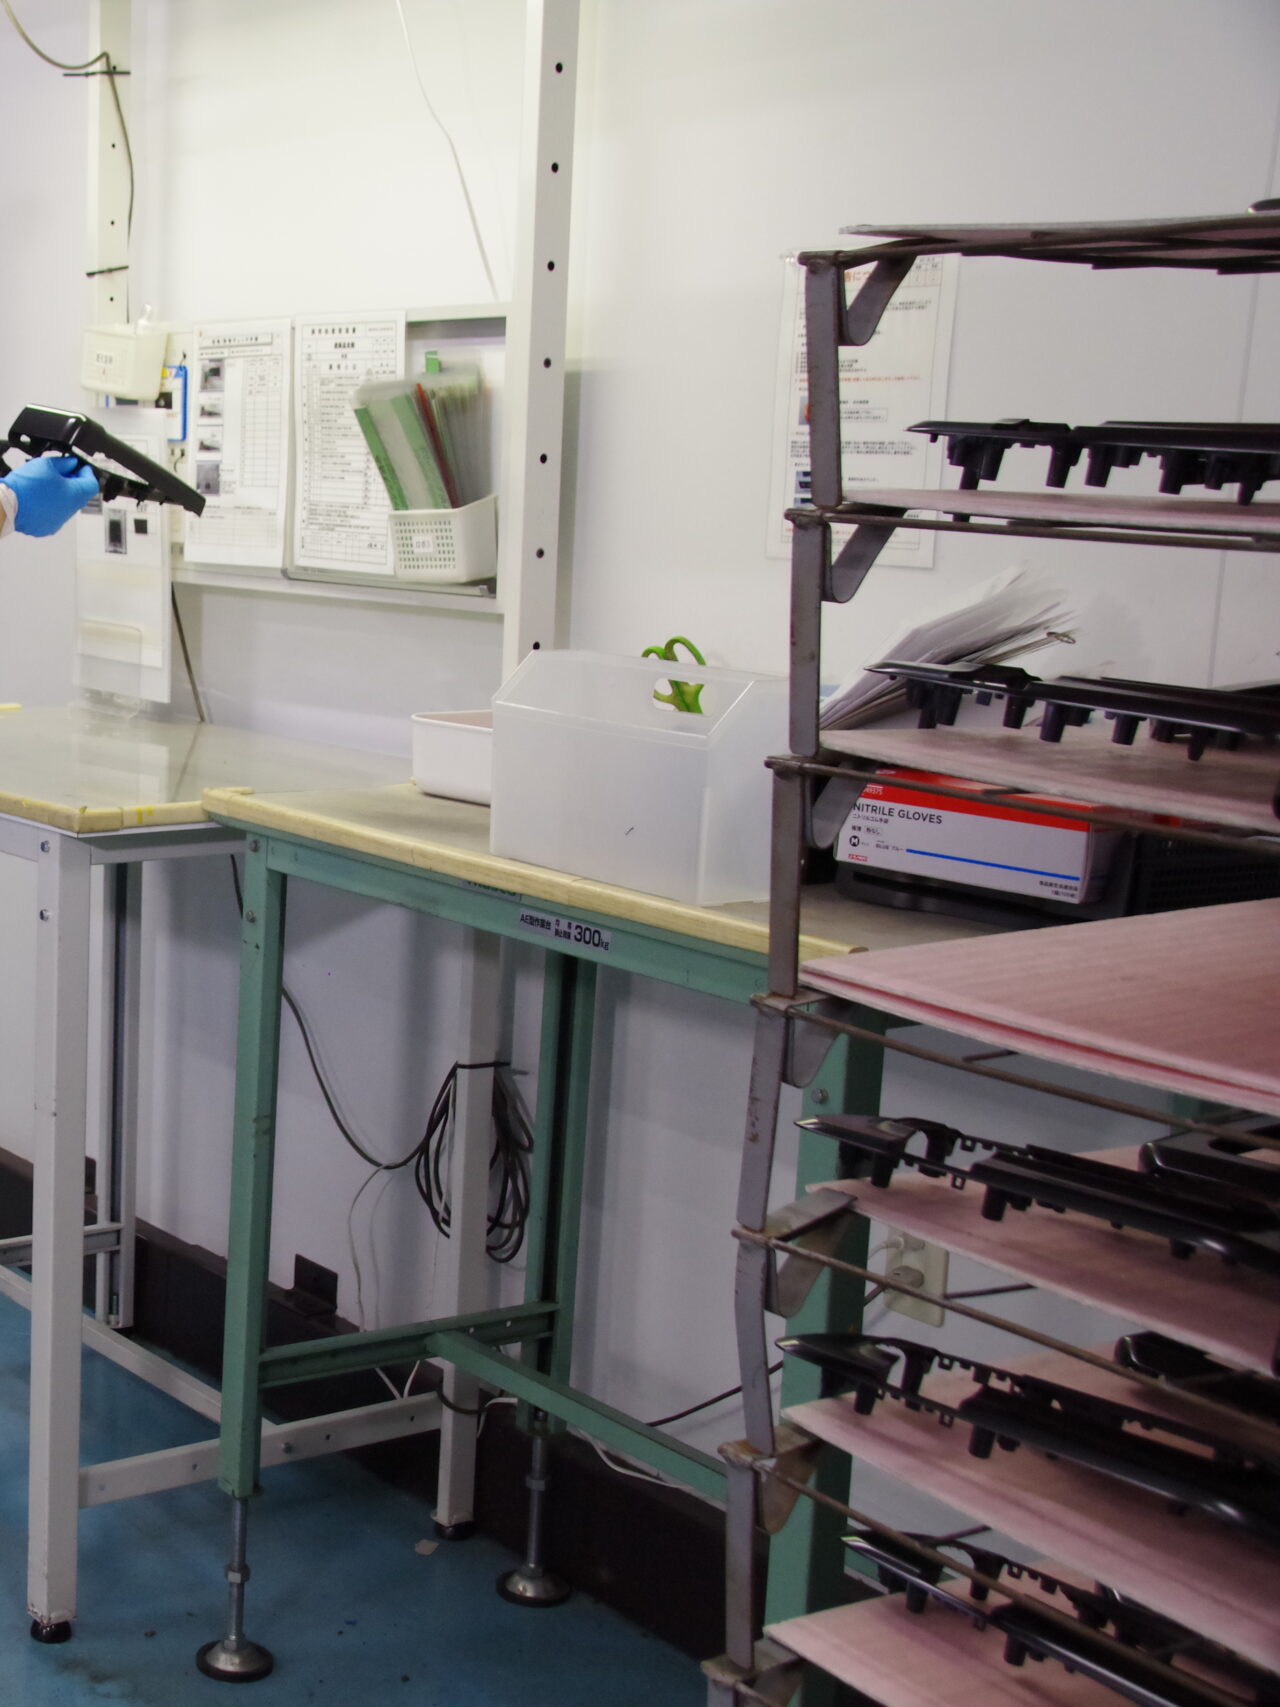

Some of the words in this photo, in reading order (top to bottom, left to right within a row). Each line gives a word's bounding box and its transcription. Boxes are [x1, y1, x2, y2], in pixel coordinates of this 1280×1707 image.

[853, 803, 895, 817] NITRILE
[898, 809, 943, 825] GLOVES
[850, 836, 860, 846] M
